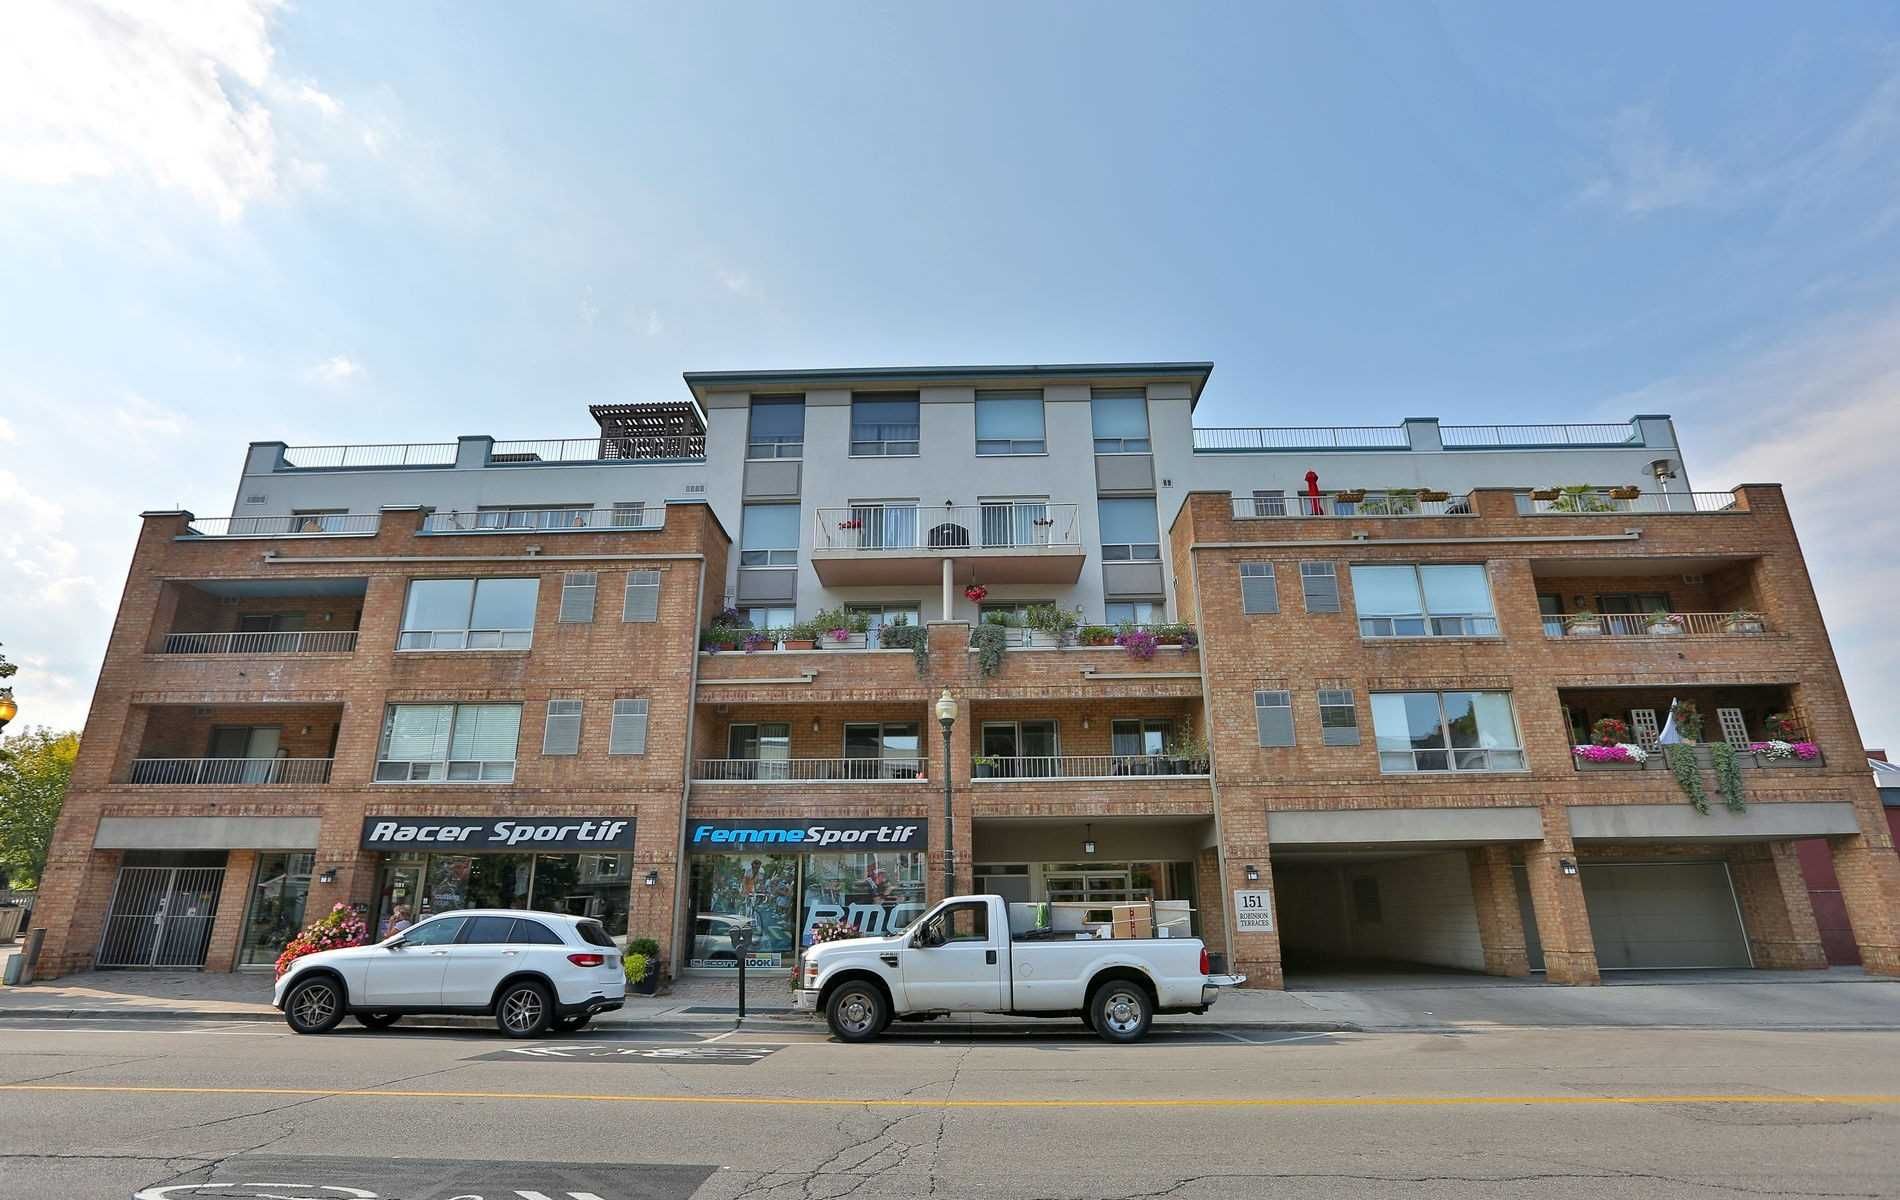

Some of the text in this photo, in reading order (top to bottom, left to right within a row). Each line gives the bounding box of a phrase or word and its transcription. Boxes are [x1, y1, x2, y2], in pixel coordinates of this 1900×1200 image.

[369, 820, 629, 846] Racer Sportif
[1242, 896, 1263, 908] 151
[1240, 919, 1271, 927] TERRACES
[703, 960, 738, 968] SCOTT
[746, 959, 775, 968] LOOK
